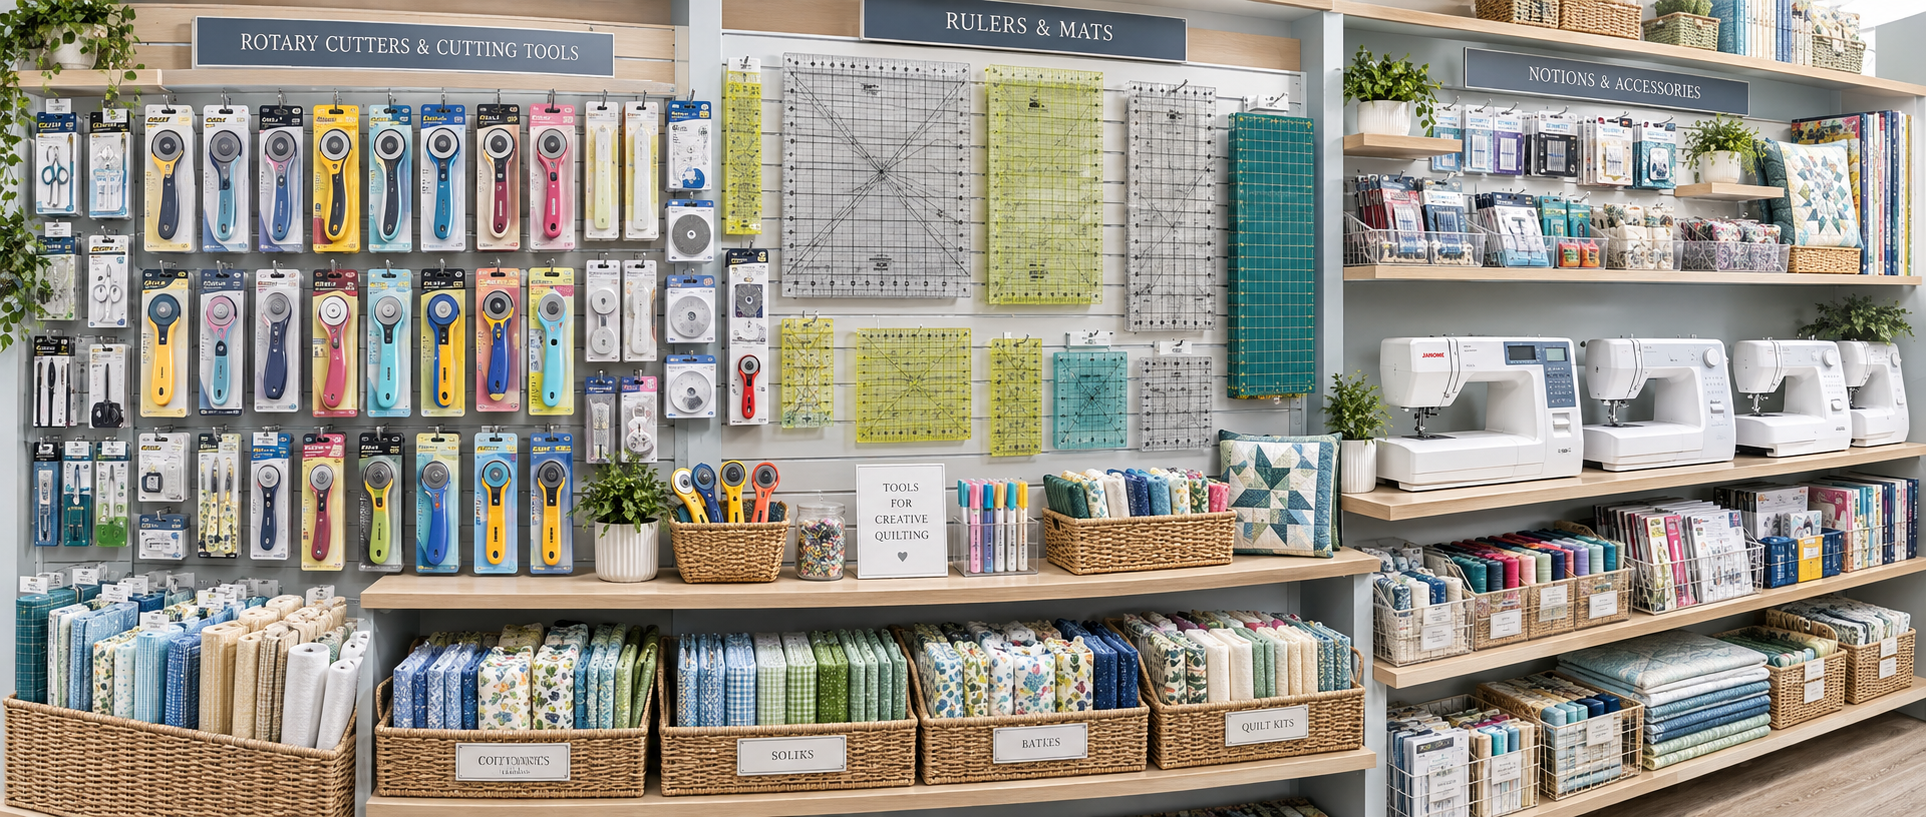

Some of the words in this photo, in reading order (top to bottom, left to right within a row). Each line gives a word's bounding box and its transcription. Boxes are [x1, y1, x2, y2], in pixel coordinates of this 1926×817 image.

[946, 11, 1027, 35] RULERS
[1036, 19, 1051, 37] &
[1059, 20, 1113, 41] MATS
[240, 33, 319, 51] ROTARY
[325, 35, 410, 54] CUTTERS
[416, 38, 430, 55] &
[436, 39, 517, 58] CUTTING
[523, 43, 579, 61] TOOLS
[1528, 65, 1595, 87] NOTIONS
[1600, 74, 1610, 89] &
[1615, 76, 1701, 99] ACCESSORIES
[882, 483, 919, 493] TOOLS
[891, 498, 912, 508] FOR
[874, 514, 929, 525] CREATIVE
[874, 530, 929, 542] QUILTING
[1241, 720, 1271, 734] QUILT
[1273, 718, 1295, 729] KITS
